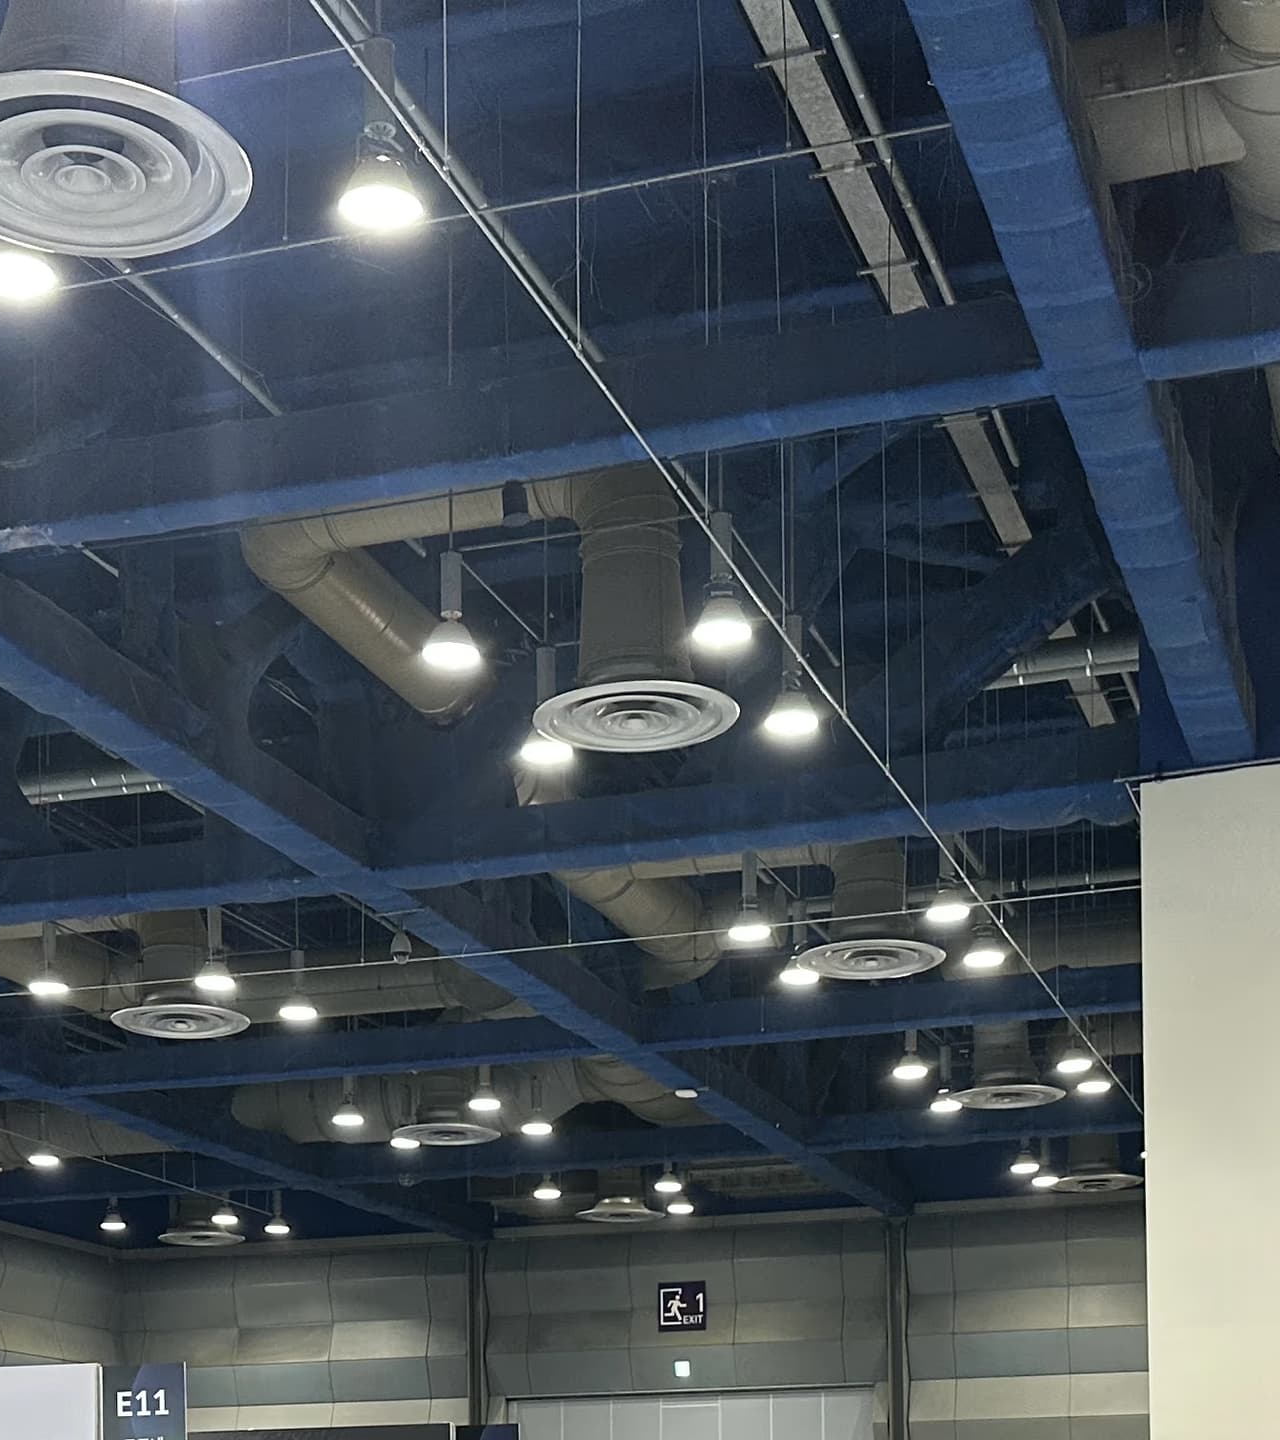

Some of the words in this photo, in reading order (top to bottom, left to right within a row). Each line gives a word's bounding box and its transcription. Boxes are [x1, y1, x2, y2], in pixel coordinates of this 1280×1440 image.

[695, 1292, 704, 1312] 1
[682, 1314, 704, 1325] EXIT
[116, 1389, 170, 1417] E11
